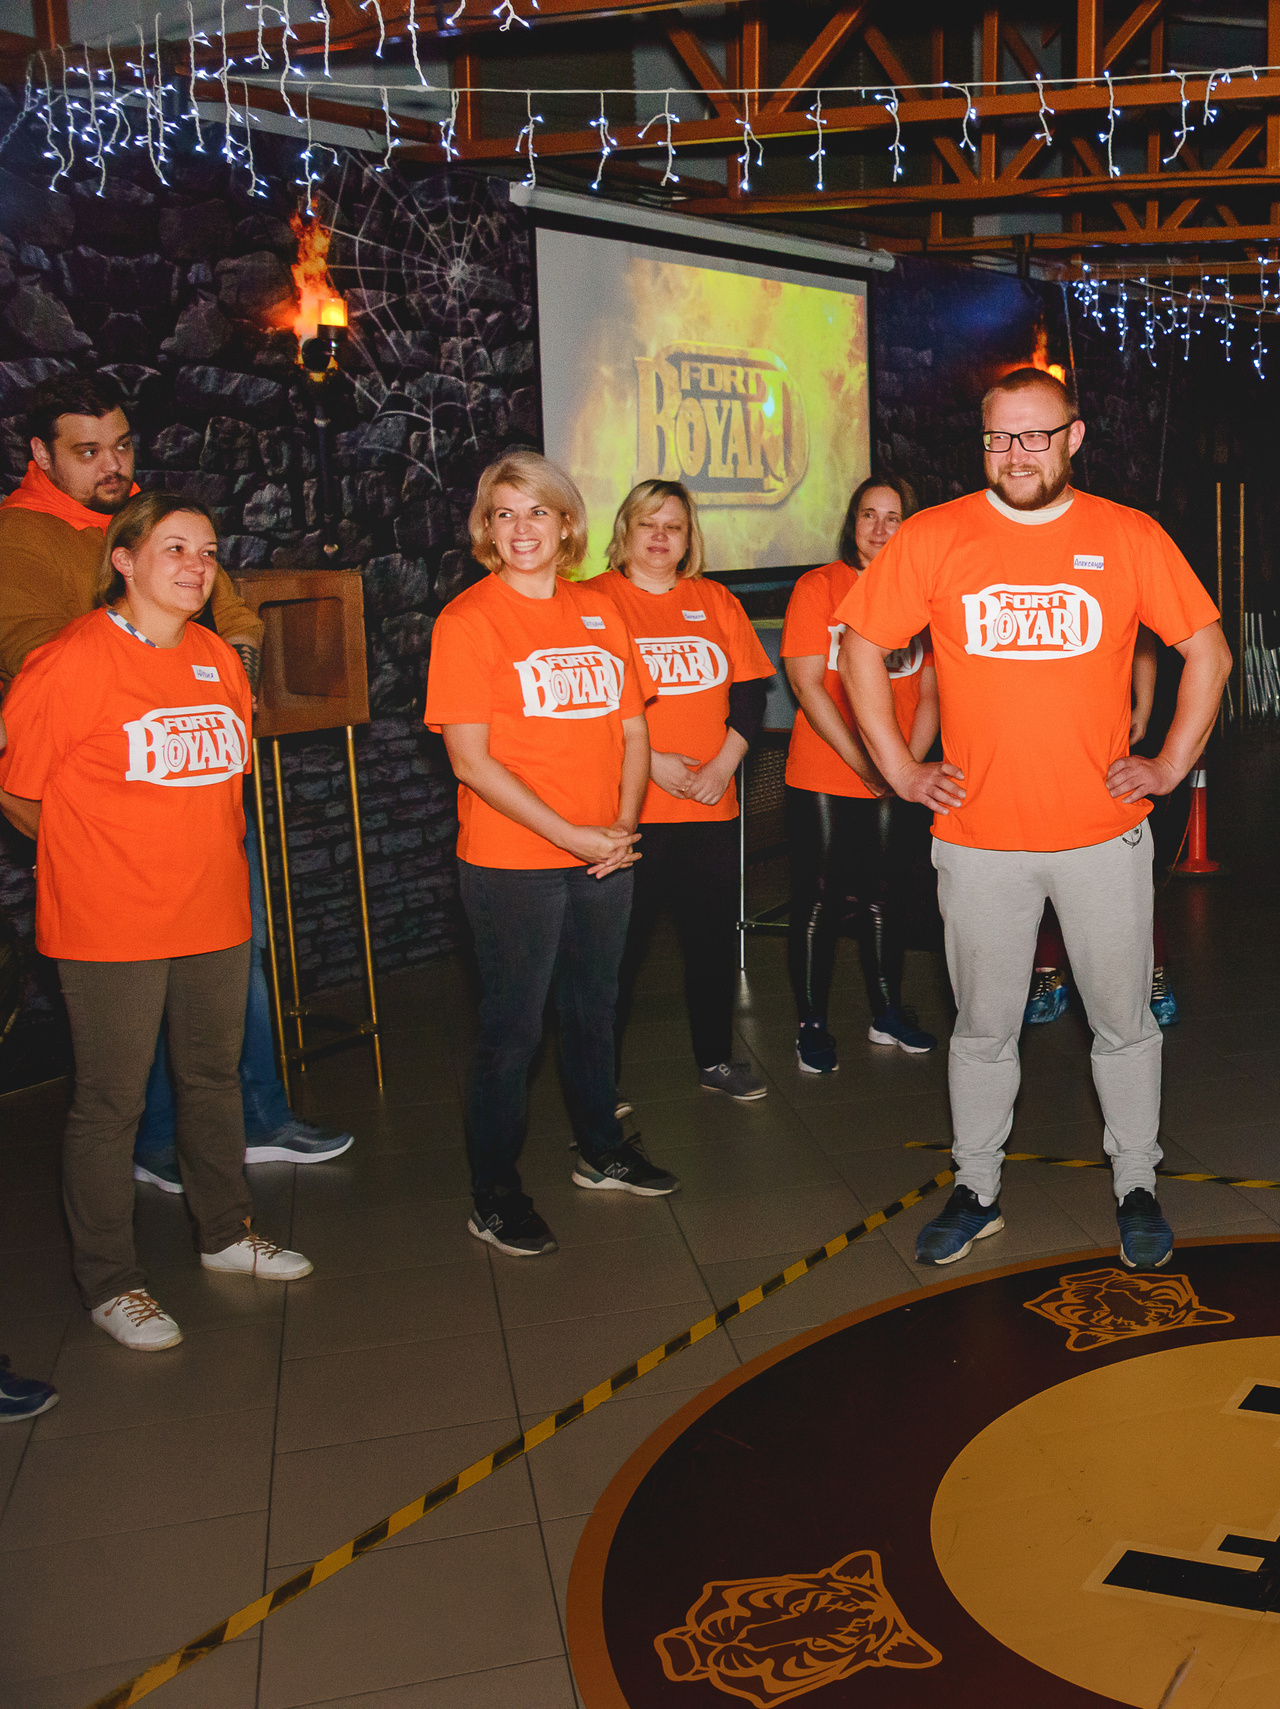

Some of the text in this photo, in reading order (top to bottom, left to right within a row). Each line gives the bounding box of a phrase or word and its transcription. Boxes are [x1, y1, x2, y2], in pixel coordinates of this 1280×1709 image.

[680, 360, 766, 396] FORT
[635, 356, 808, 494] BOYARD
[1000, 593, 1063, 609] FORT
[962, 594, 1102, 655] BOYARD
[546, 653, 602, 669] FORT
[639, 643, 695, 654] FORT
[643, 643, 728, 685] OYARD
[513, 654, 625, 717] BOYARD
[163, 714, 219, 733] FORT
[123, 716, 249, 781] BOYARD
